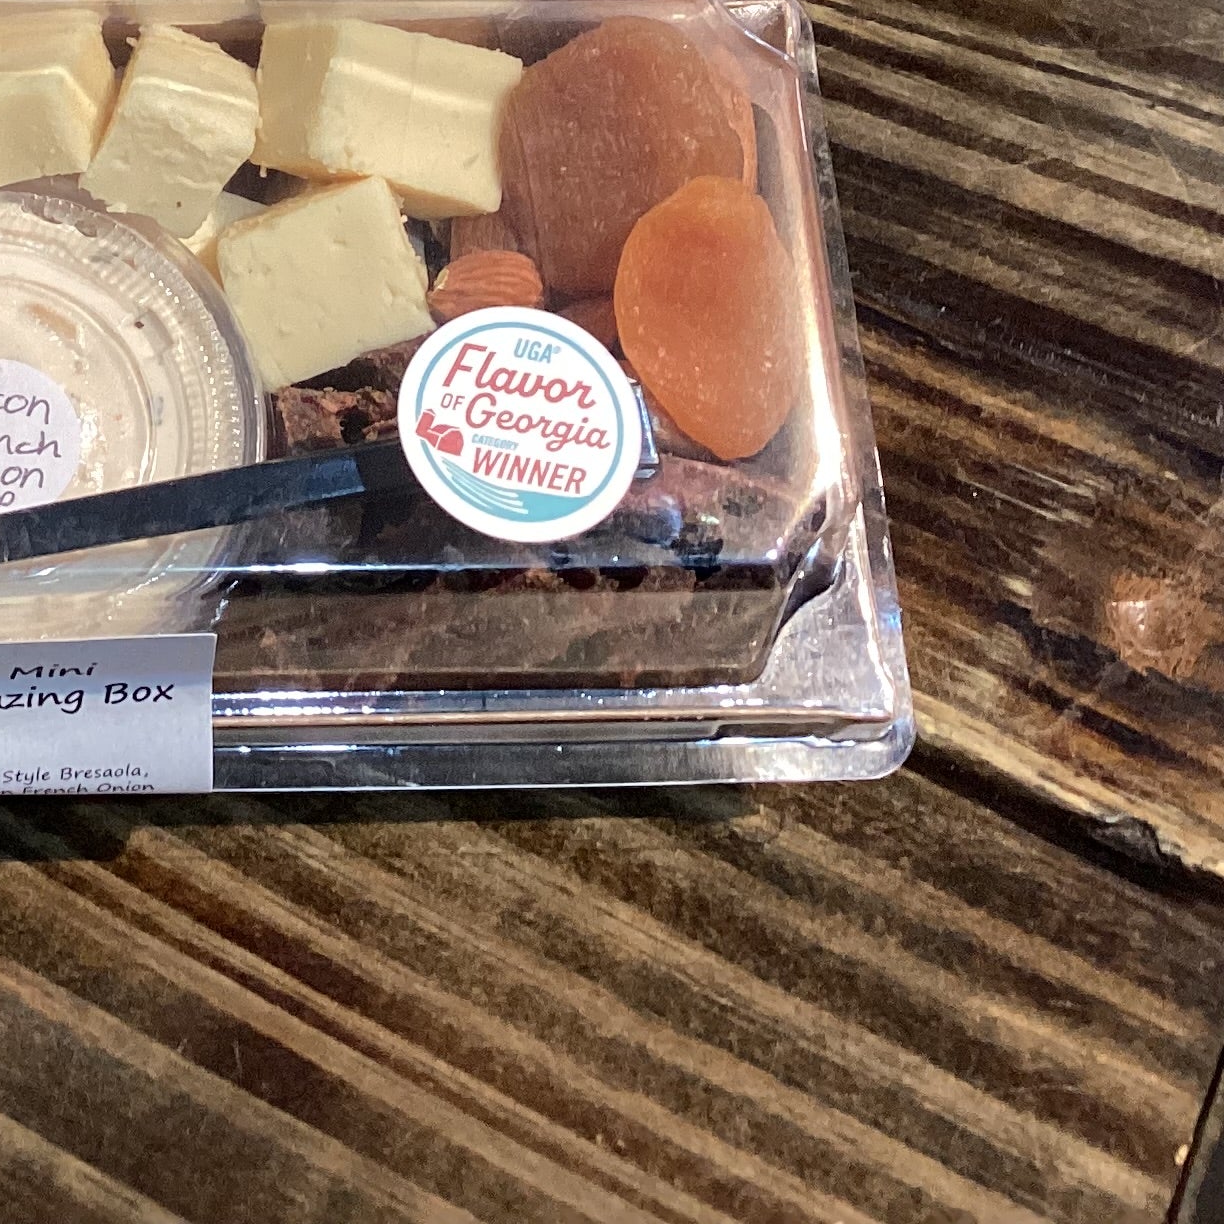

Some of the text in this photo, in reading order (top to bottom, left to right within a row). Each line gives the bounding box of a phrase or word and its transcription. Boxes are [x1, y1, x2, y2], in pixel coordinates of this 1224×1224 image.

[442, 342, 596, 409] Flavor
[440, 392, 611, 452] OF Georgia
[471, 433, 519, 451] CATEGORY
[472, 447, 587, 495] WINNER
[9, 661, 99, 681] Mini
[104, 682, 175, 705] Box
[2, 767, 51, 785] Style
[60, 763, 150, 781] Bresaola,
[97, 780, 156, 794] Onion
